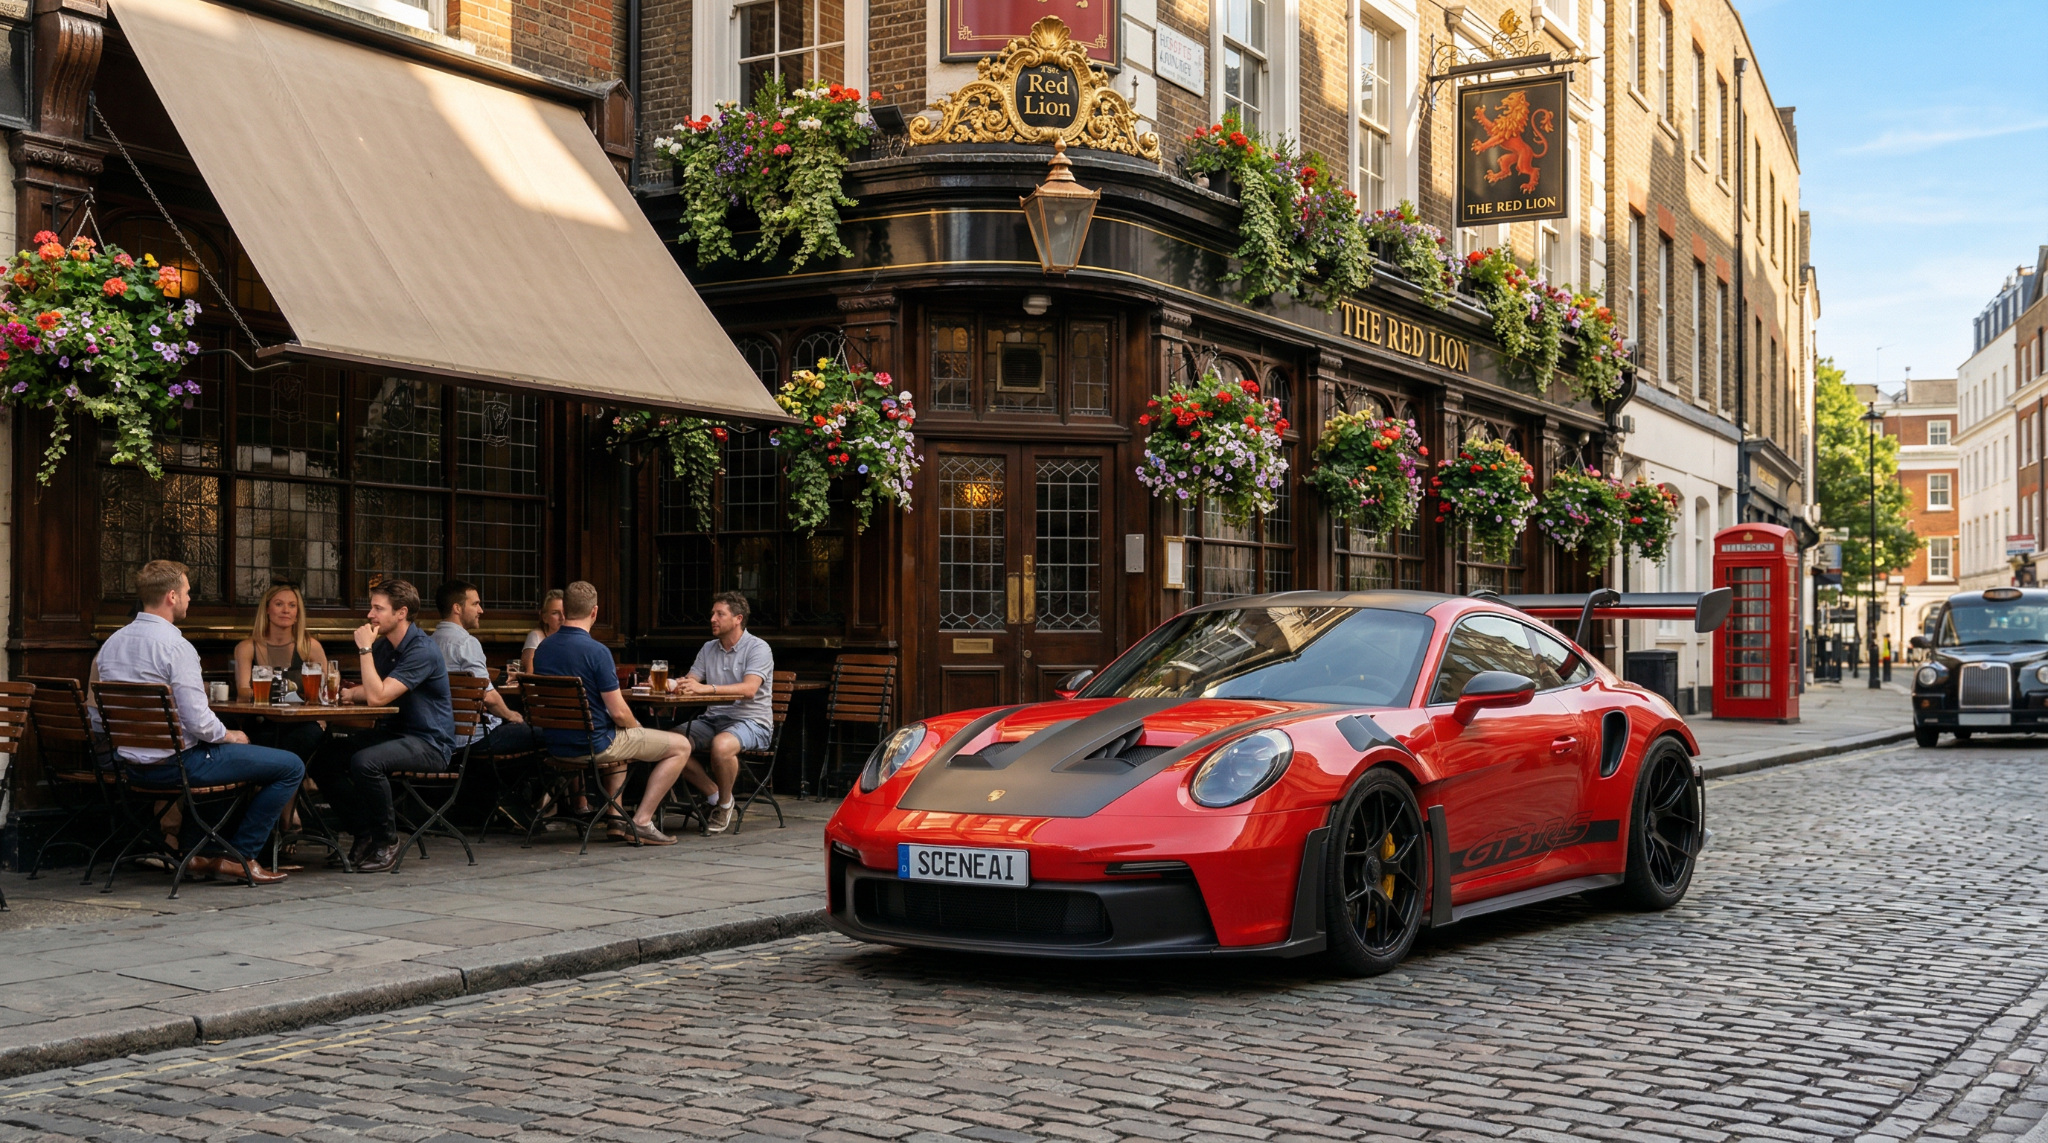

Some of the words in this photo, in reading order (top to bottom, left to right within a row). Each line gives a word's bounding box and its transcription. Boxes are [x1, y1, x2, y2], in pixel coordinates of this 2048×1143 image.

[1028, 74, 1069, 95] Red
[1024, 95, 1071, 117] Lion
[1467, 203, 1493, 215] THE
[1497, 200, 1523, 212] RED
[1526, 196, 1557, 210] LION
[1340, 300, 1382, 346] THE
[1386, 316, 1425, 358] RED
[1428, 331, 1470, 373] LION
[918, 850, 1014, 881] SCENEAI
